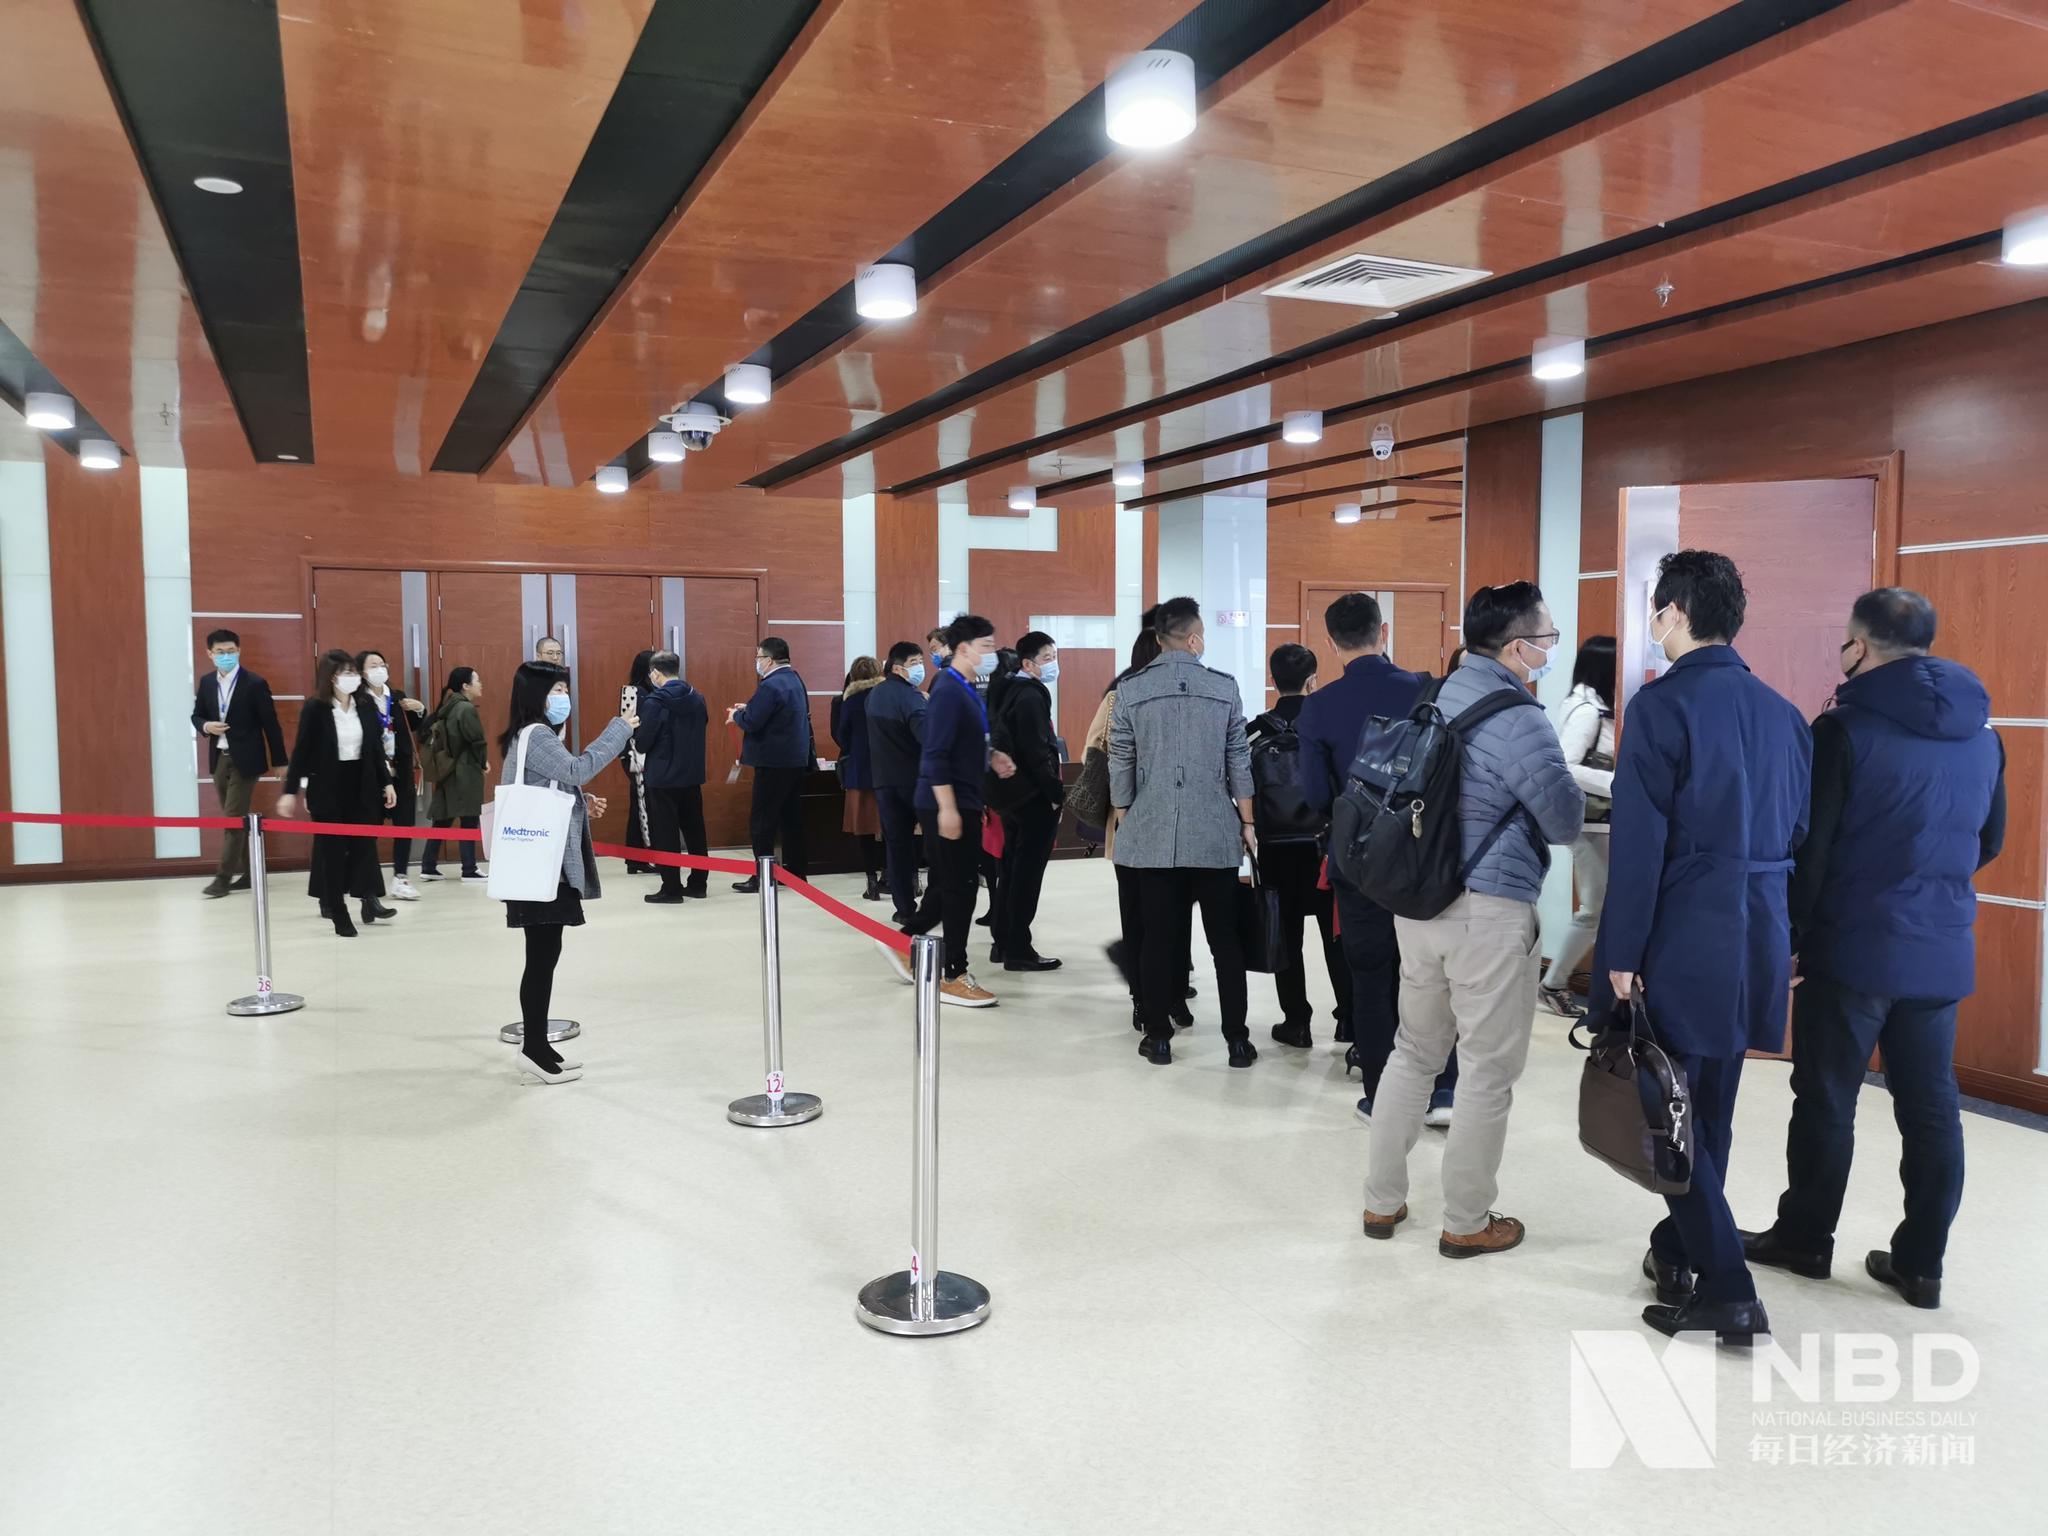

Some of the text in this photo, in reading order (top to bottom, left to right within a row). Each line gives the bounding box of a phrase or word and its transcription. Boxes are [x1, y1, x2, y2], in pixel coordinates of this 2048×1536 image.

[502, 826, 551, 837] Medtronic
[257, 980, 272, 992] 28
[767, 1078, 782, 1093] 12
[911, 1255, 919, 1276] 4
